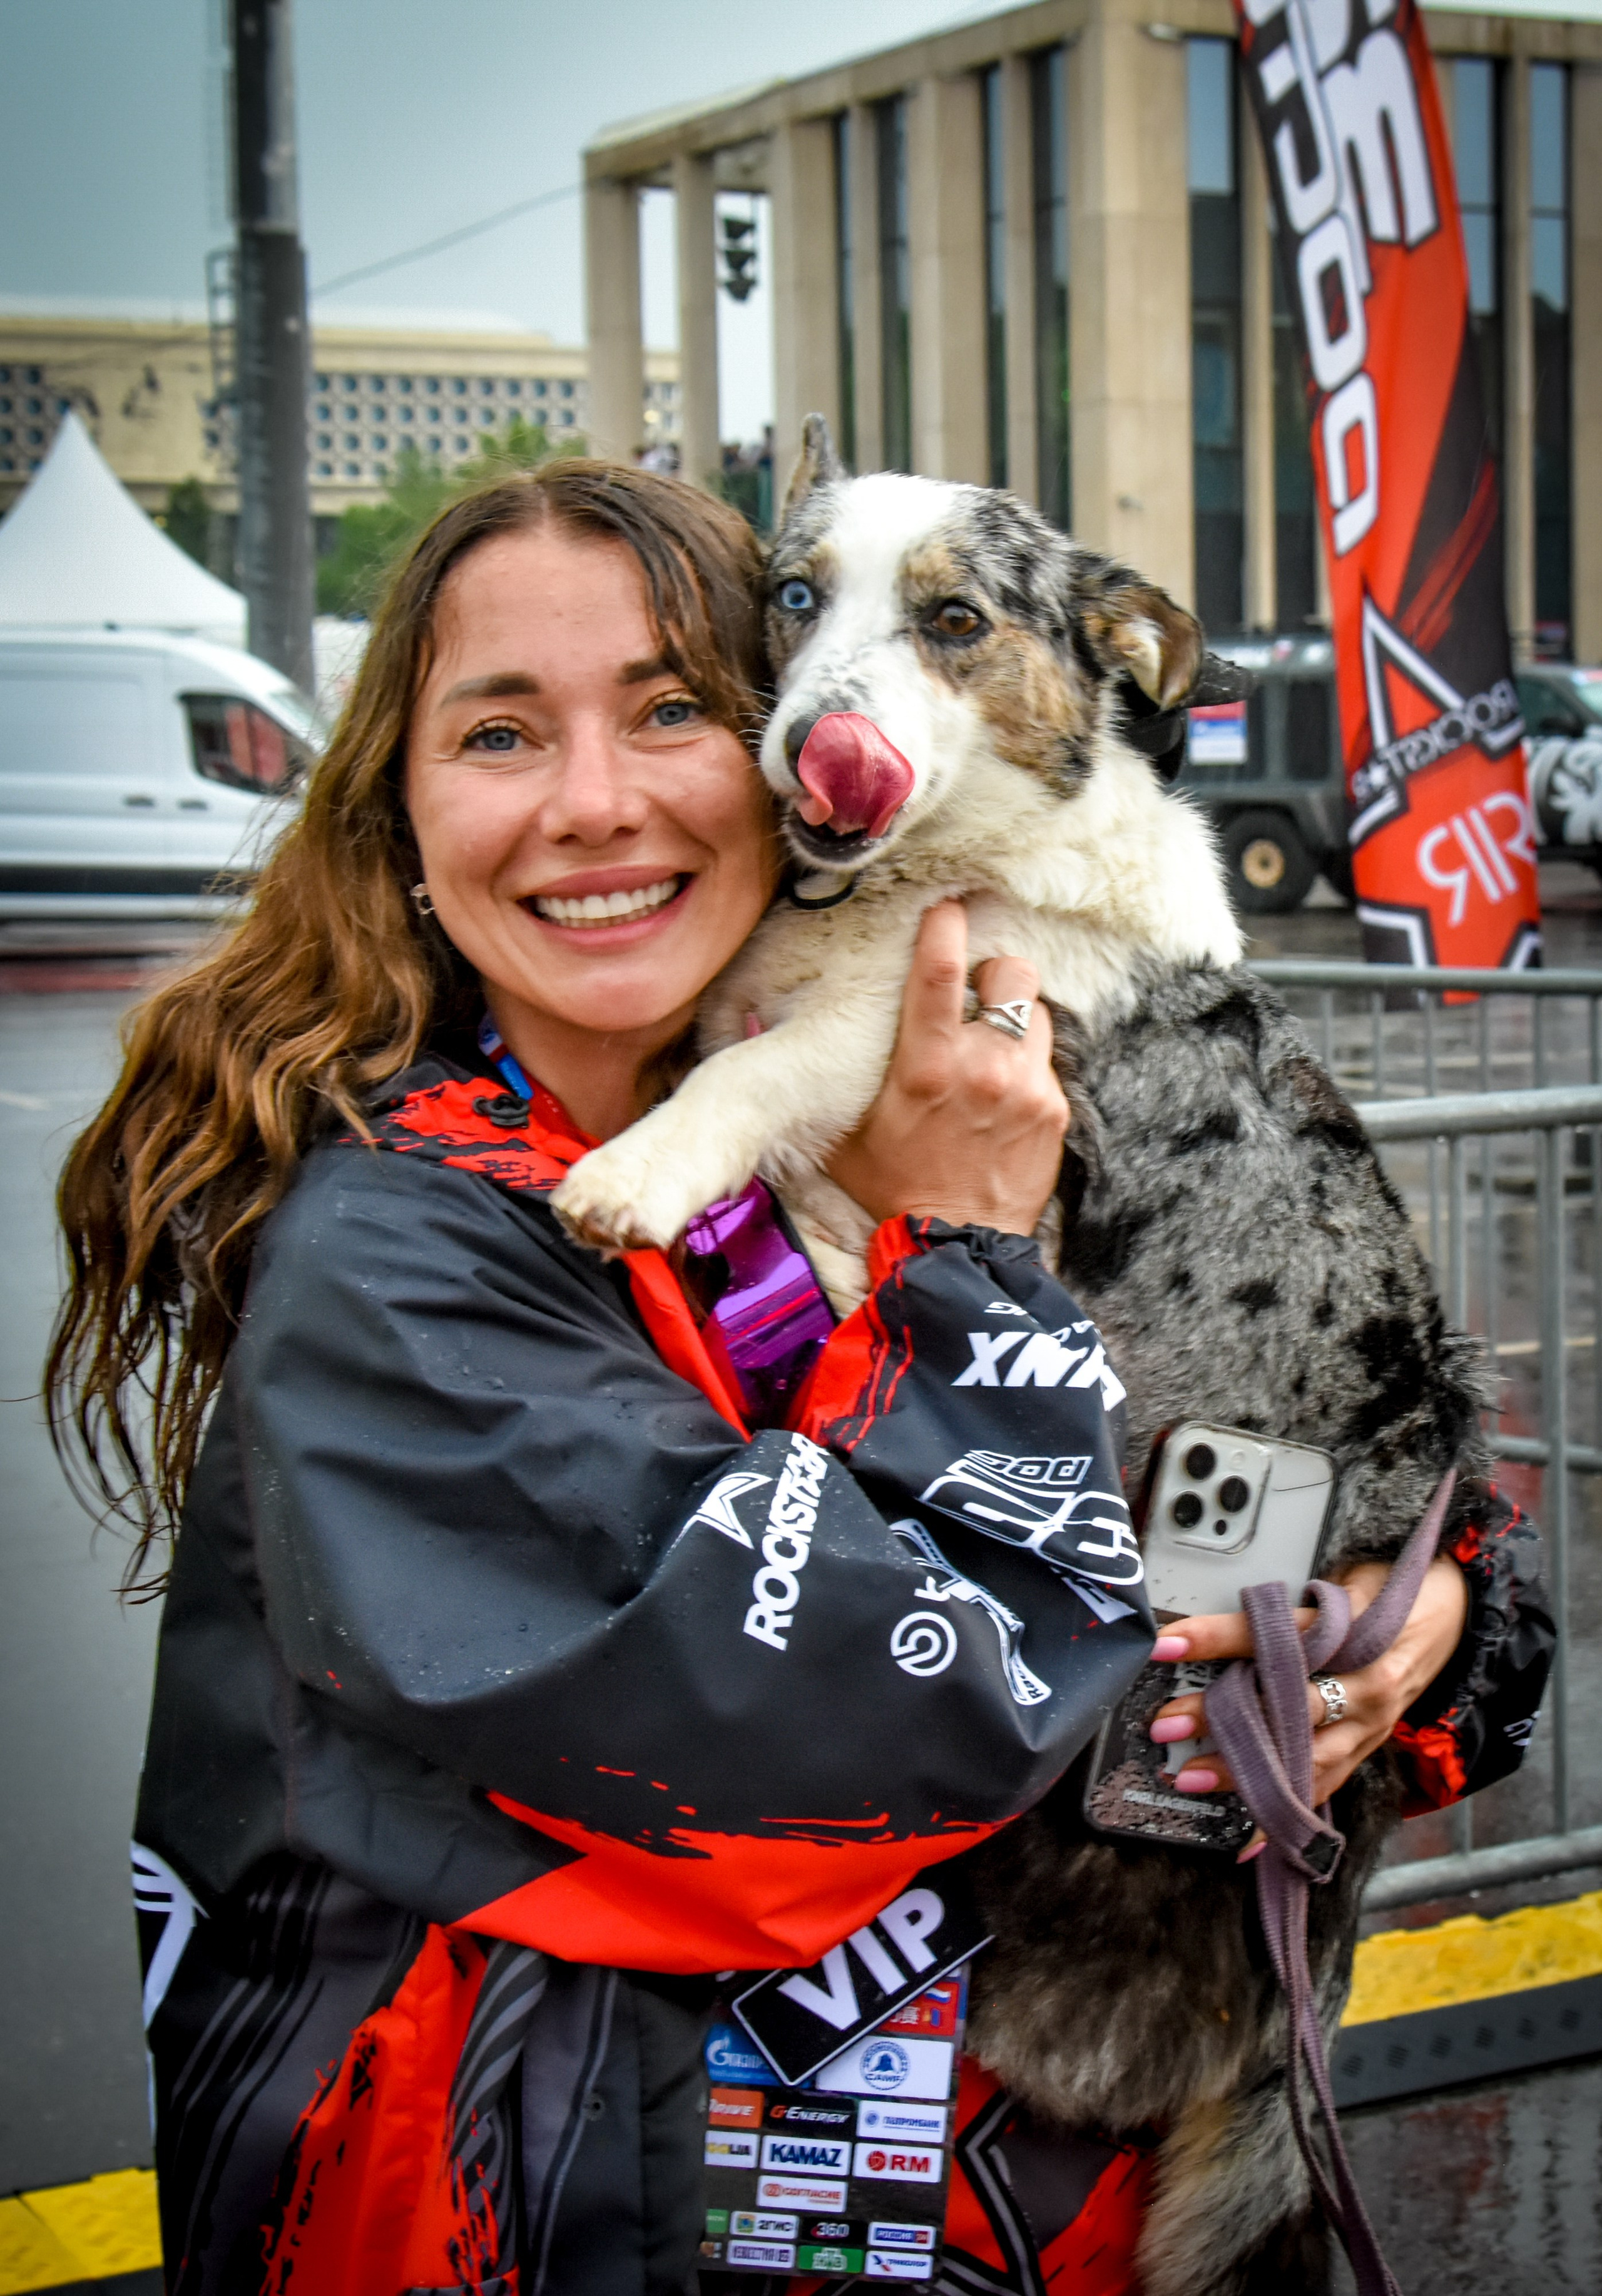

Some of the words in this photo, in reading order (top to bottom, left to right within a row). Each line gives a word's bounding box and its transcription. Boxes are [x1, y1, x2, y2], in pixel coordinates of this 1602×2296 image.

[743, 1432, 831, 1652] ROCKSTAR
[777, 1888, 945, 2031] VIP
[770, 2143, 842, 2167] KAMAZ
[891, 2154, 931, 2173] RM
[816, 2222, 850, 2238] 360
